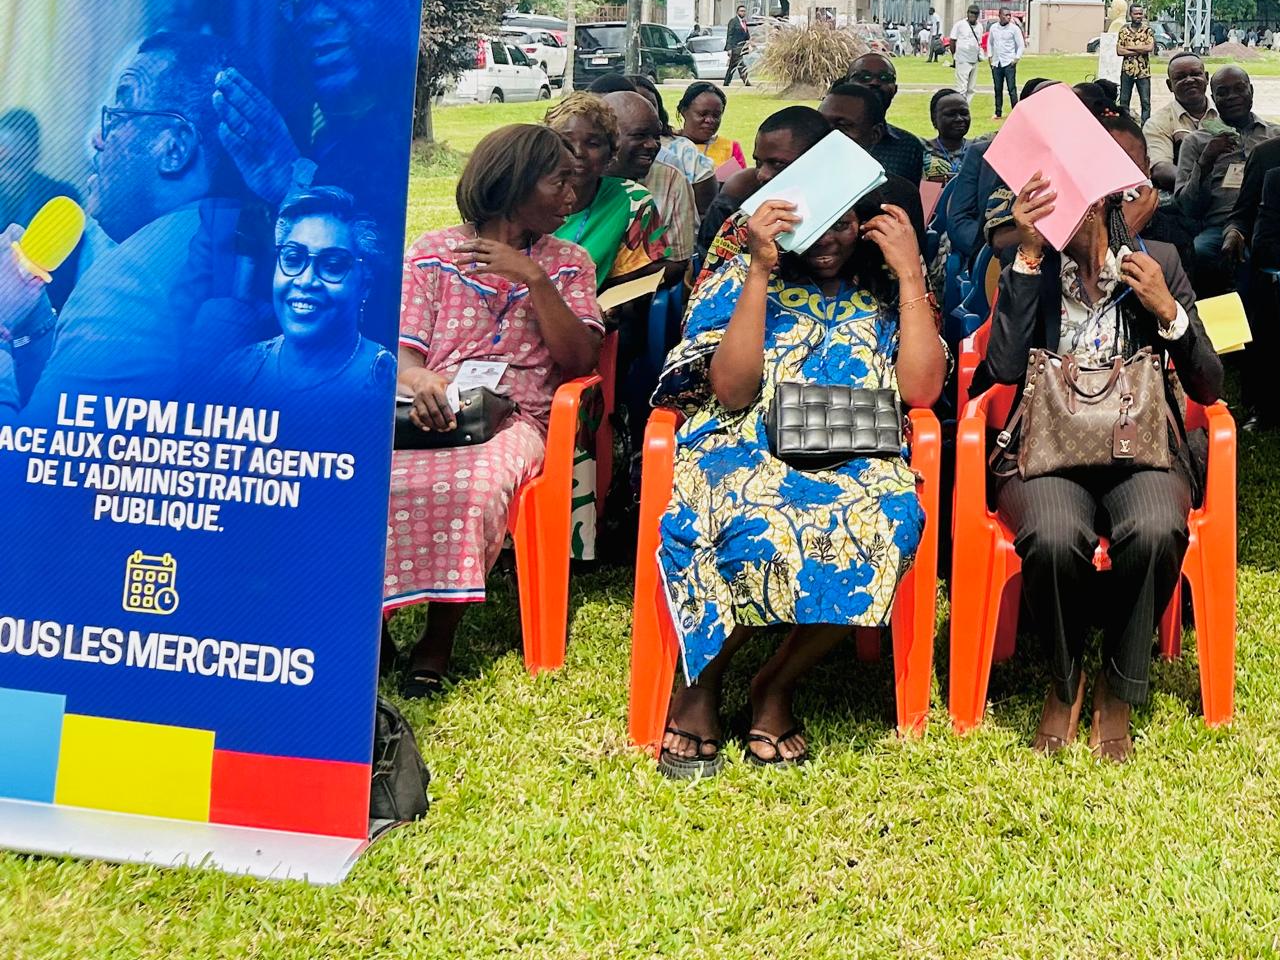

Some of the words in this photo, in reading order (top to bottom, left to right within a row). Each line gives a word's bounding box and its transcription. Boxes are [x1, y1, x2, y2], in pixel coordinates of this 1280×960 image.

[57, 392, 98, 428] LE
[104, 396, 179, 435] VPM
[184, 402, 280, 444] LIHAU
[0, 425, 48, 454] ACE
[49, 430, 104, 459] AUX
[108, 434, 210, 468] CADRES
[214, 443, 247, 471] ET
[248, 447, 356, 480] AGENTS
[26, 457, 59, 486] DE
[62, 461, 301, 508] L'ADMINISTRATION
[94, 494, 224, 533] PUBLIQUE.
[0, 616, 62, 658] OUS
[63, 623, 124, 666] LES
[126, 631, 315, 687] MERCREDIS
